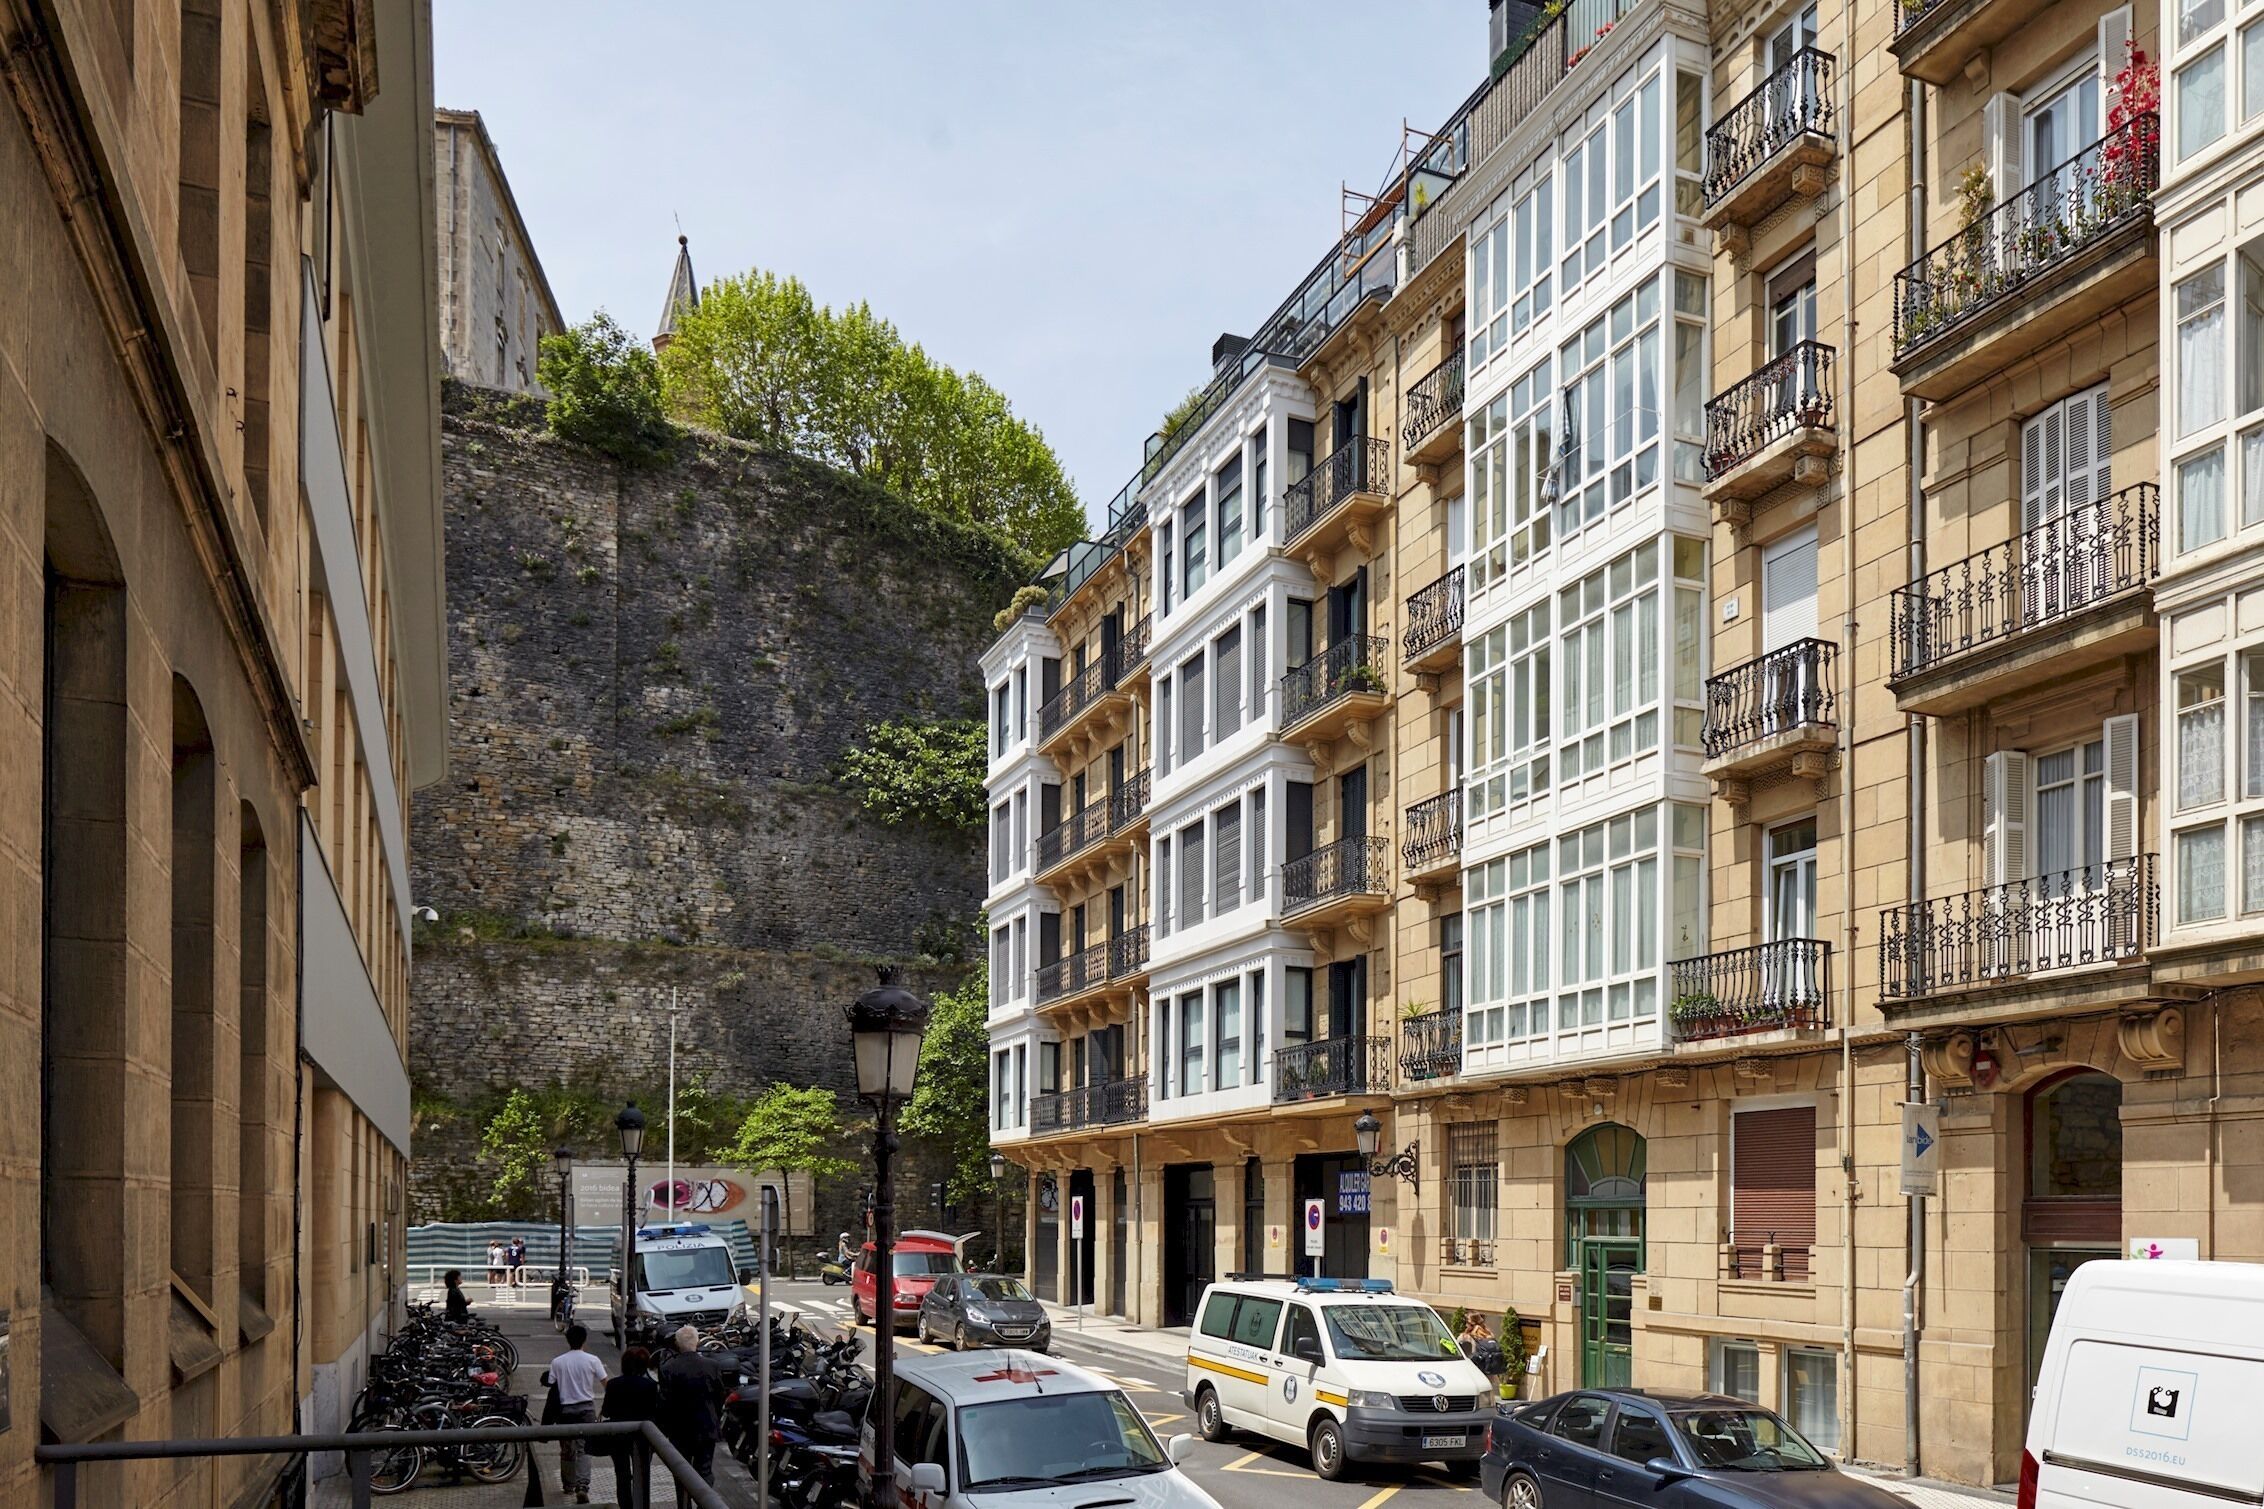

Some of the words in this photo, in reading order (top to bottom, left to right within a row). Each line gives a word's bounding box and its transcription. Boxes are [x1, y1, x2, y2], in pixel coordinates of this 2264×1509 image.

[1340, 1195, 1352, 1211] 943
[1353, 1195, 1366, 1211] 420
[657, 1242, 705, 1250] POLIZIA
[1228, 1346, 1258, 1360] ATESTATUAK
[1430, 1438, 1448, 1447] 6305
[2126, 1447, 2186, 1466] DSS2016.EU
